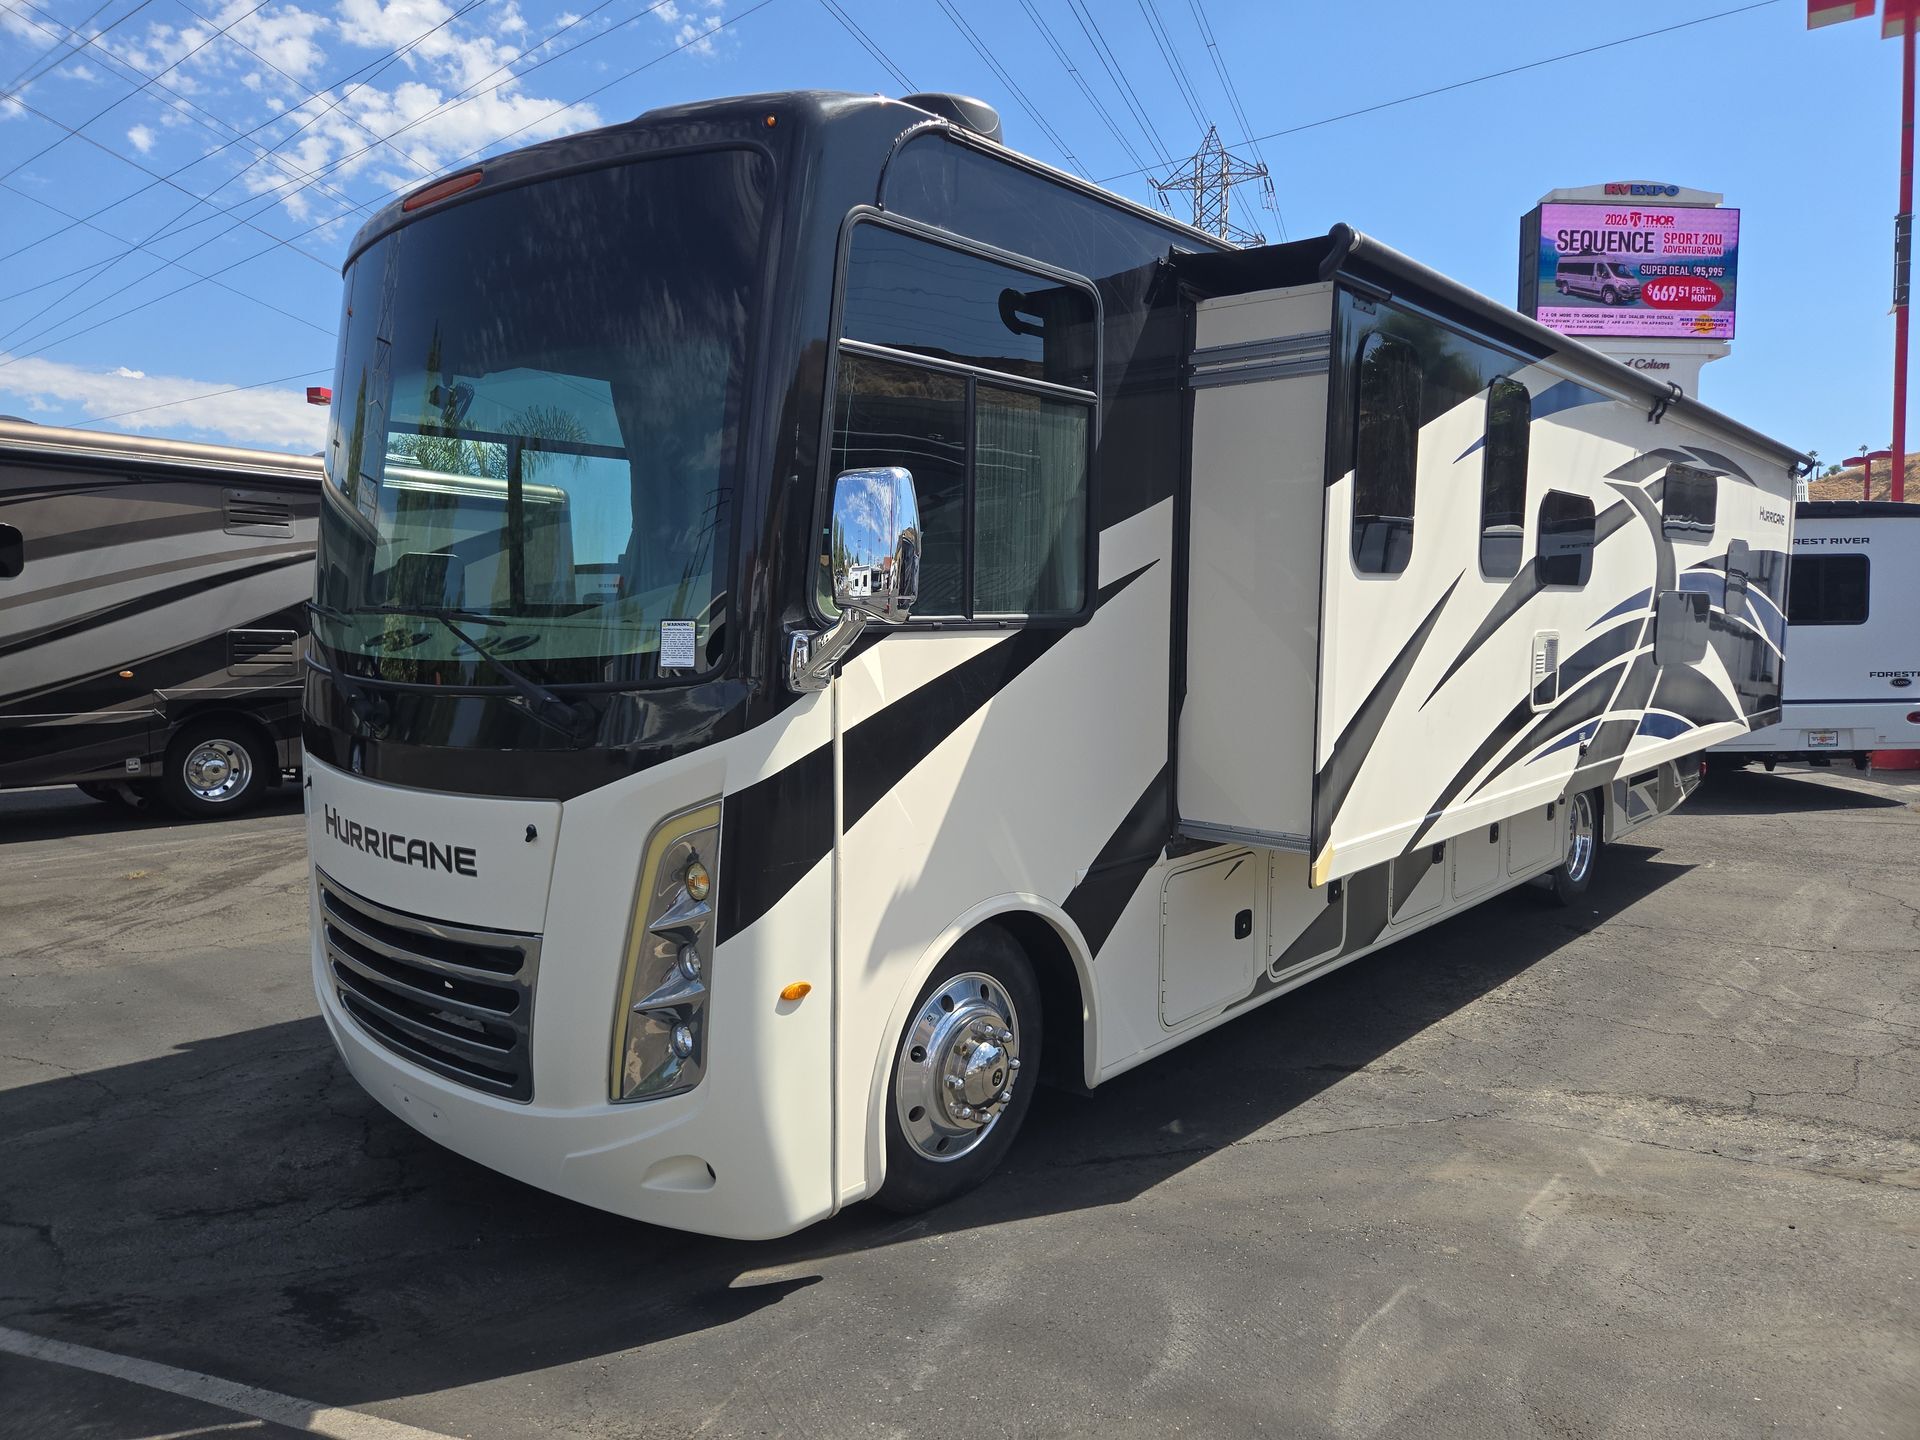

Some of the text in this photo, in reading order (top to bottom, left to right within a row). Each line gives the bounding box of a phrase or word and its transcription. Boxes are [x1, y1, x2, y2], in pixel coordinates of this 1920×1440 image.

[1605, 214, 1675, 226] 2026 THOR
[1557, 230, 1655, 253] SEQUENCE
[1663, 232, 1722, 246] SPORT 20U
[1663, 245, 1722, 255] ADVENTURE VAN
[1641, 265, 1667, 275] SUPER
[1669, 266, 1690, 276] DEAL
[1691, 294, 1717, 303] MONTH
[1635, 359, 1670, 369] Colton
[1759, 505, 1785, 526] HURRICANE
[324, 803, 478, 878] HURRICANE
